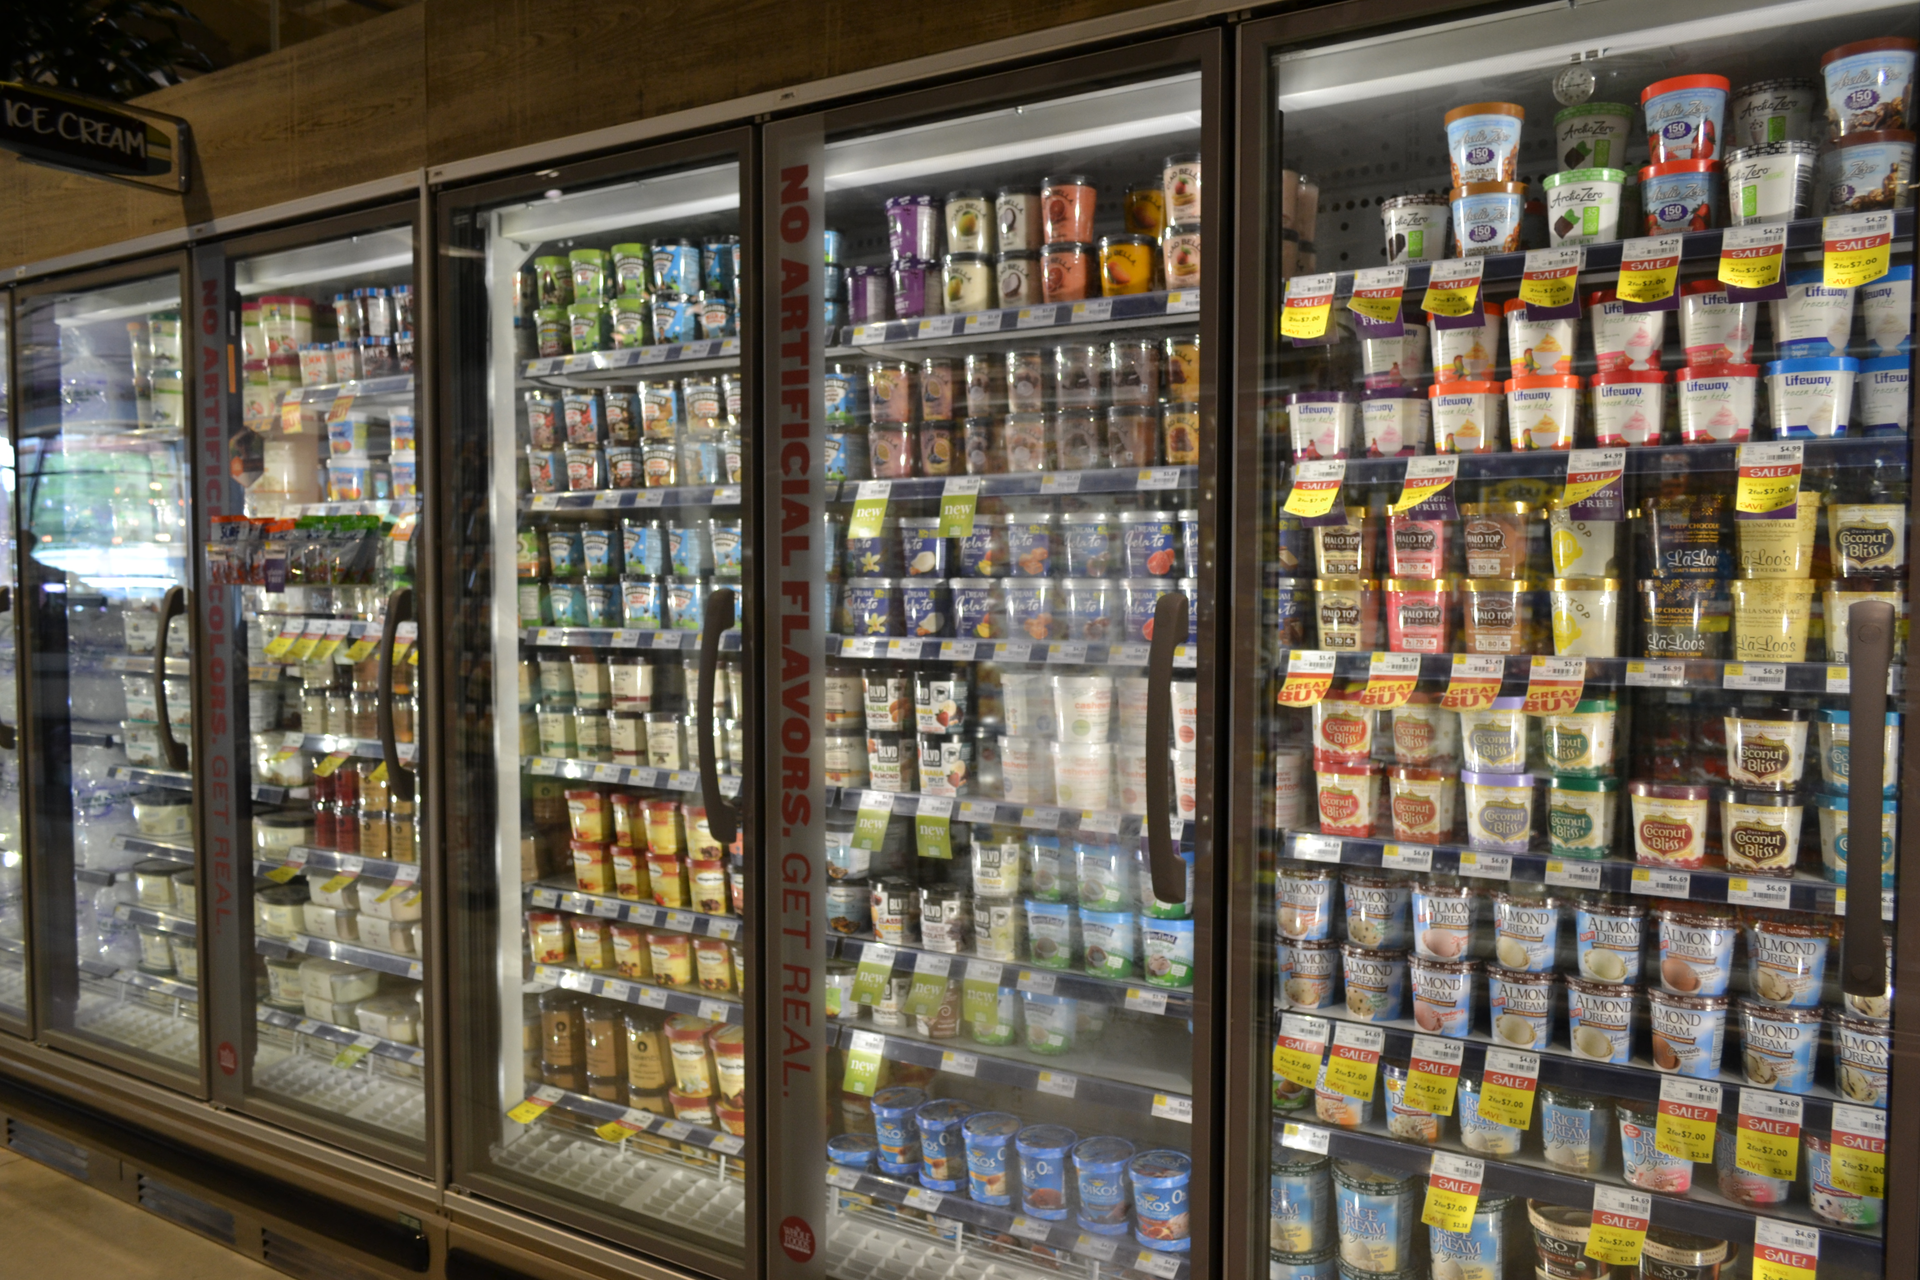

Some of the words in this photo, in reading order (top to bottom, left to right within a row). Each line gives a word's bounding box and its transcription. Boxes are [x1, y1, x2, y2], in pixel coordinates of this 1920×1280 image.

[1850, 89, 1872, 101] 150
[1741, 98, 1775, 119] Arctic
[1773, 95, 1799, 110] Zero
[6, 100, 55, 134] ICE
[58, 112, 146, 158] CREAM
[1562, 124, 1592, 141] Arctic
[1592, 121, 1615, 135] Zero
[1667, 122, 1685, 133] 150
[1471, 148, 1489, 158] 150
[1745, 164, 1771, 181] Zero
[1550, 191, 1580, 208] Arctic
[1580, 187, 1605, 201] Zero
[780, 164, 810, 244] NO
[1663, 204, 1682, 215] 150
[1865, 215, 1888, 223] $4.29
[1473, 226, 1490, 236] 150
[1836, 238, 1881, 251] SALE!
[1560, 250, 1579, 258] $4.29
[1732, 247, 1774, 259] SALE!
[1631, 259, 1670, 271] SALE!
[203, 280, 217, 335] NO
[1686, 381, 1731, 392] Lifeway
[1785, 376, 1833, 387] Lifeway
[1513, 390, 1553, 402] Lifeway
[1601, 386, 1644, 397] Lifeway
[1437, 396, 1474, 407] Lifeway
[780, 257, 810, 567] ARTIFICIAL
[1780, 445, 1801, 453] $4.99
[1749, 467, 1792, 478] SALE!
[944, 504, 972, 515] new
[1414, 503, 1448, 512] FREE
[1578, 499, 1615, 509] FREE
[856, 507, 882, 518] new
[1324, 535, 1342, 545] HALO
[1343, 535, 1361, 545] TOP
[1396, 535, 1414, 544] HALO
[1416, 534, 1433, 544] TOP
[1466, 535, 1484, 544] HALO
[1485, 534, 1502, 543] TOP
[1839, 532, 1889, 545] Coconut
[1849, 544, 1879, 559] Bliss
[1322, 610, 1340, 619] HALO
[1341, 610, 1357, 619] TOP
[1402, 610, 1421, 620] HALO
[1422, 610, 1439, 619] TOP
[1763, 668, 1784, 676] $6.99
[869, 685, 886, 698] BLVD
[1285, 681, 1327, 692] GREAT
[1369, 683, 1413, 693] GREAT
[1450, 685, 1497, 695] GREAT
[1278, 689, 1327, 703] BUY
[1359, 690, 1412, 705] BUY
[1531, 689, 1579, 699] GREAT
[1440, 693, 1495, 709] BUY
[1521, 696, 1579, 713] BUY
[780, 580, 812, 838] FLAVORS.
[1325, 722, 1363, 734] Coconut
[1334, 734, 1357, 745] Bliss
[878, 746, 898, 757] BLVD
[923, 750, 940, 761] BLVD
[1747, 758, 1776, 774] Bliss
[212, 758, 230, 825] GET
[1393, 802, 1430, 815] Coconut
[859, 818, 885, 829] new
[920, 824, 946, 836] new
[1642, 826, 1689, 839] Coconut
[1734, 831, 1783, 845] Coconut
[1651, 838, 1679, 851] Bliss
[981, 850, 999, 862] BLVD
[1744, 844, 1774, 858] Bliss
[214, 835, 231, 934] REAL.
[1668, 875, 1688, 884] $6.69
[1766, 884, 1787, 892] $6.69
[781, 852, 811, 950] GET
[1348, 888, 1398, 903] ALMOND
[924, 905, 941, 917] BLVD
[1496, 905, 1550, 925] ALMOND
[1498, 921, 1542, 935] DREAM
[1597, 932, 1637, 944] DREAM
[1669, 942, 1713, 957] DREAM
[1753, 937, 1817, 956] ALMOND
[1760, 950, 1807, 966] DREAM
[1344, 960, 1393, 976] ALMOND
[859, 970, 886, 984] new
[1347, 974, 1385, 985] DREAM
[915, 982, 942, 996] new
[1412, 977, 1461, 991] ALMOND
[967, 989, 995, 1002] new
[1431, 1008, 1465, 1020] Strawberry
[781, 963, 811, 1098] REAL.
[1339, 1048, 1372, 1062] SALE!
[1519, 1056, 1537, 1064] $4.69
[850, 1058, 876, 1072] new
[1418, 1061, 1452, 1076] SALE!
[1699, 1085, 1719, 1094] $4.69
[1779, 1098, 1800, 1107] $4.69
[1509, 1118, 1526, 1126] $2.38
[1551, 1109, 1584, 1128] RICE
[1658, 1141, 1682, 1155] SAVE
[1691, 1151, 1710, 1159] $2.38
[1739, 1157, 1765, 1172] SAVE
[1655, 1172, 1686, 1183] Strawberry
[1773, 1168, 1792, 1176] $2.38
[1081, 1182, 1119, 1196] OIKOS
[1135, 1195, 1170, 1212] OIKOS
[1631, 1196, 1650, 1204] $4.69
[1344, 1199, 1378, 1221] RICE
[1453, 1221, 1468, 1230] $2.38
[783, 1225, 810, 1240] WHOLE
[1795, 1229, 1816, 1239] $4.69
[784, 1235, 810, 1249] FOODS
[1545, 1238, 1567, 1251] SO
[1662, 1266, 1687, 1277] SO
